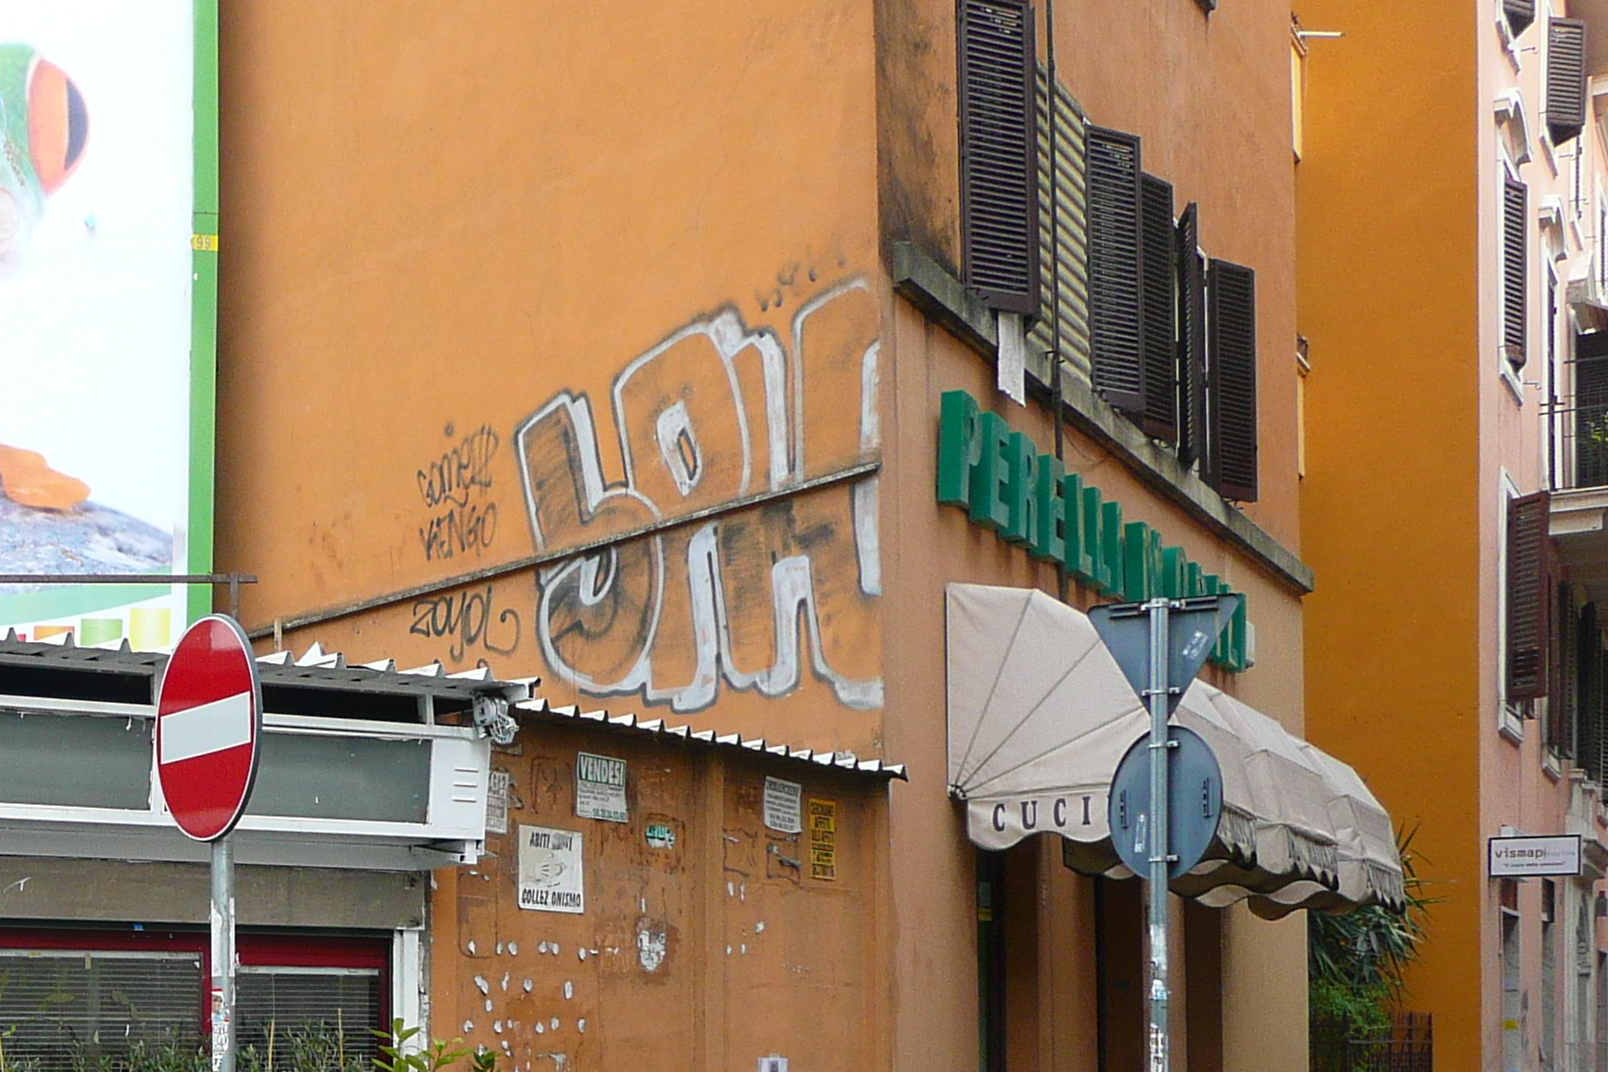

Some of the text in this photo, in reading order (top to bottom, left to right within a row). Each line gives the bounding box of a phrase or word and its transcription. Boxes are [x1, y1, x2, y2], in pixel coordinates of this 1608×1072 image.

[937, 389, 1126, 600] PERELLI
[580, 756, 623, 786] VENDESI
[992, 795, 1111, 832] CUCI
